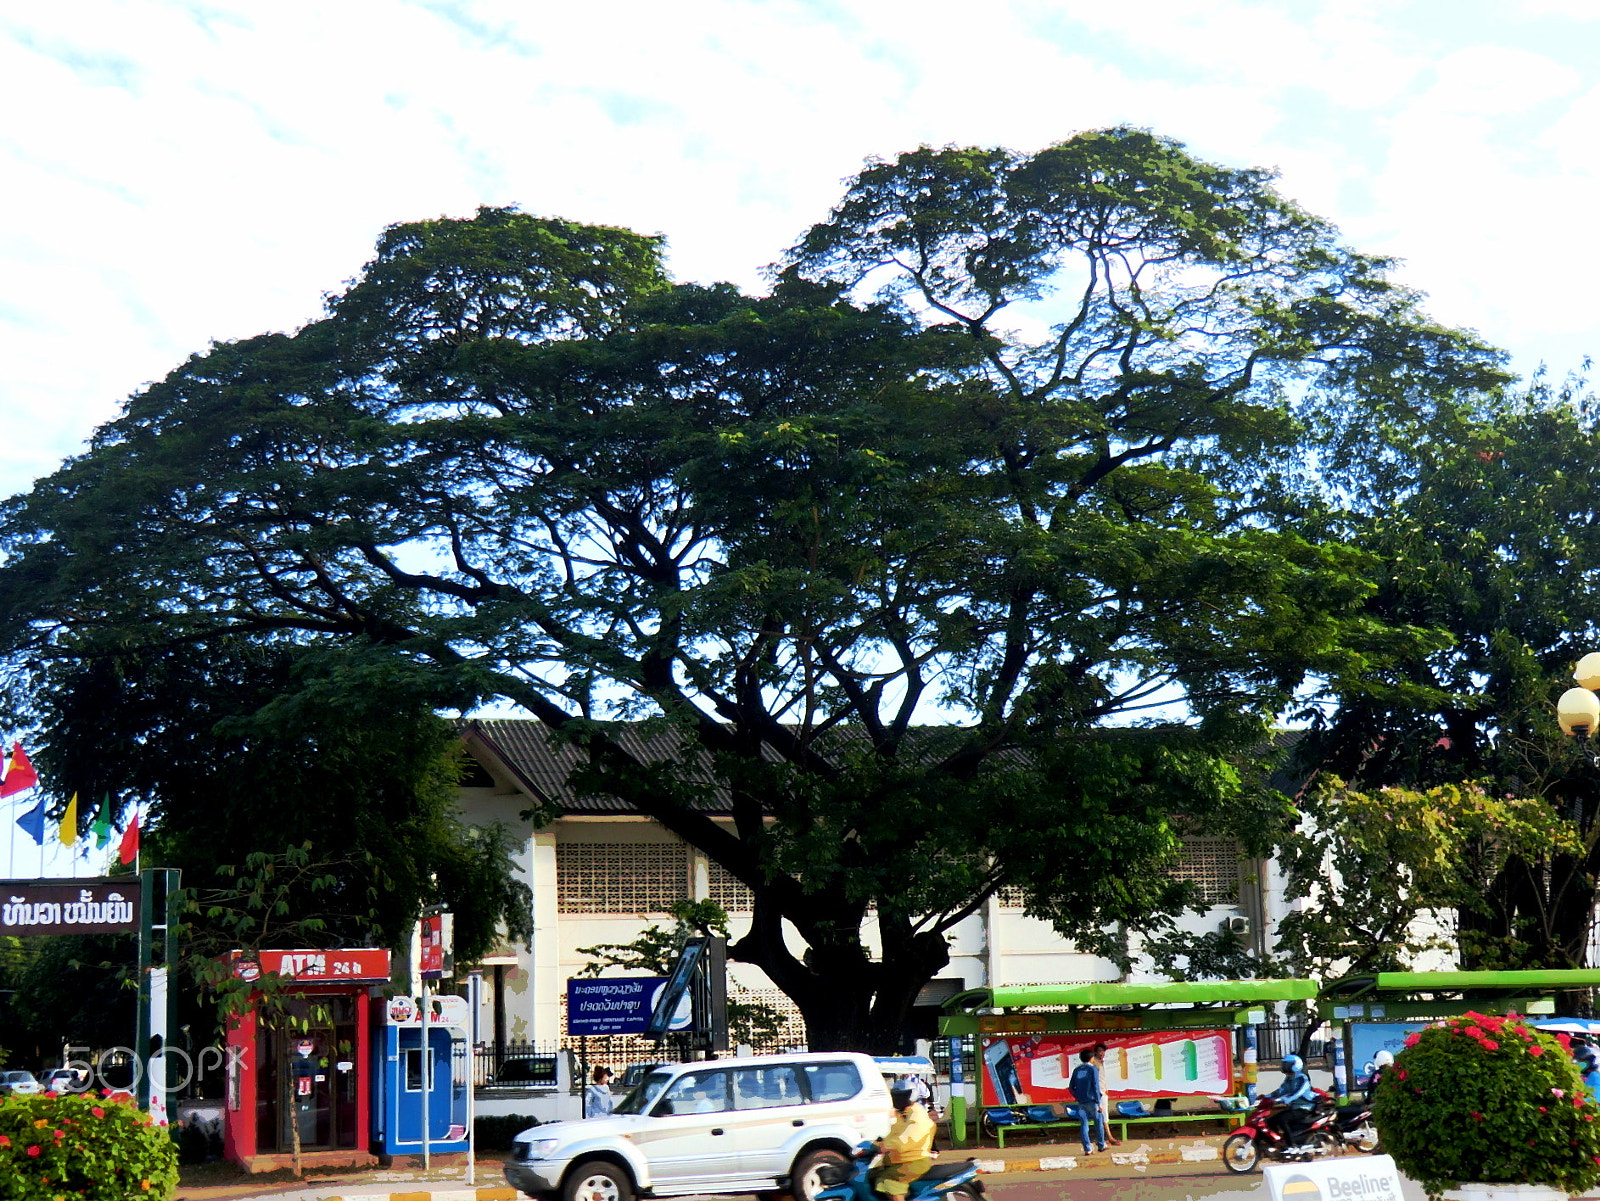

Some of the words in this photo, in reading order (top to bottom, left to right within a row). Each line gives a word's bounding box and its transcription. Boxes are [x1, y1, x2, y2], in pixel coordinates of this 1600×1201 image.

[279, 954, 325, 976] ATM
[414, 1010, 440, 1024] AM
[1327, 1174, 1391, 1198] Beeline
